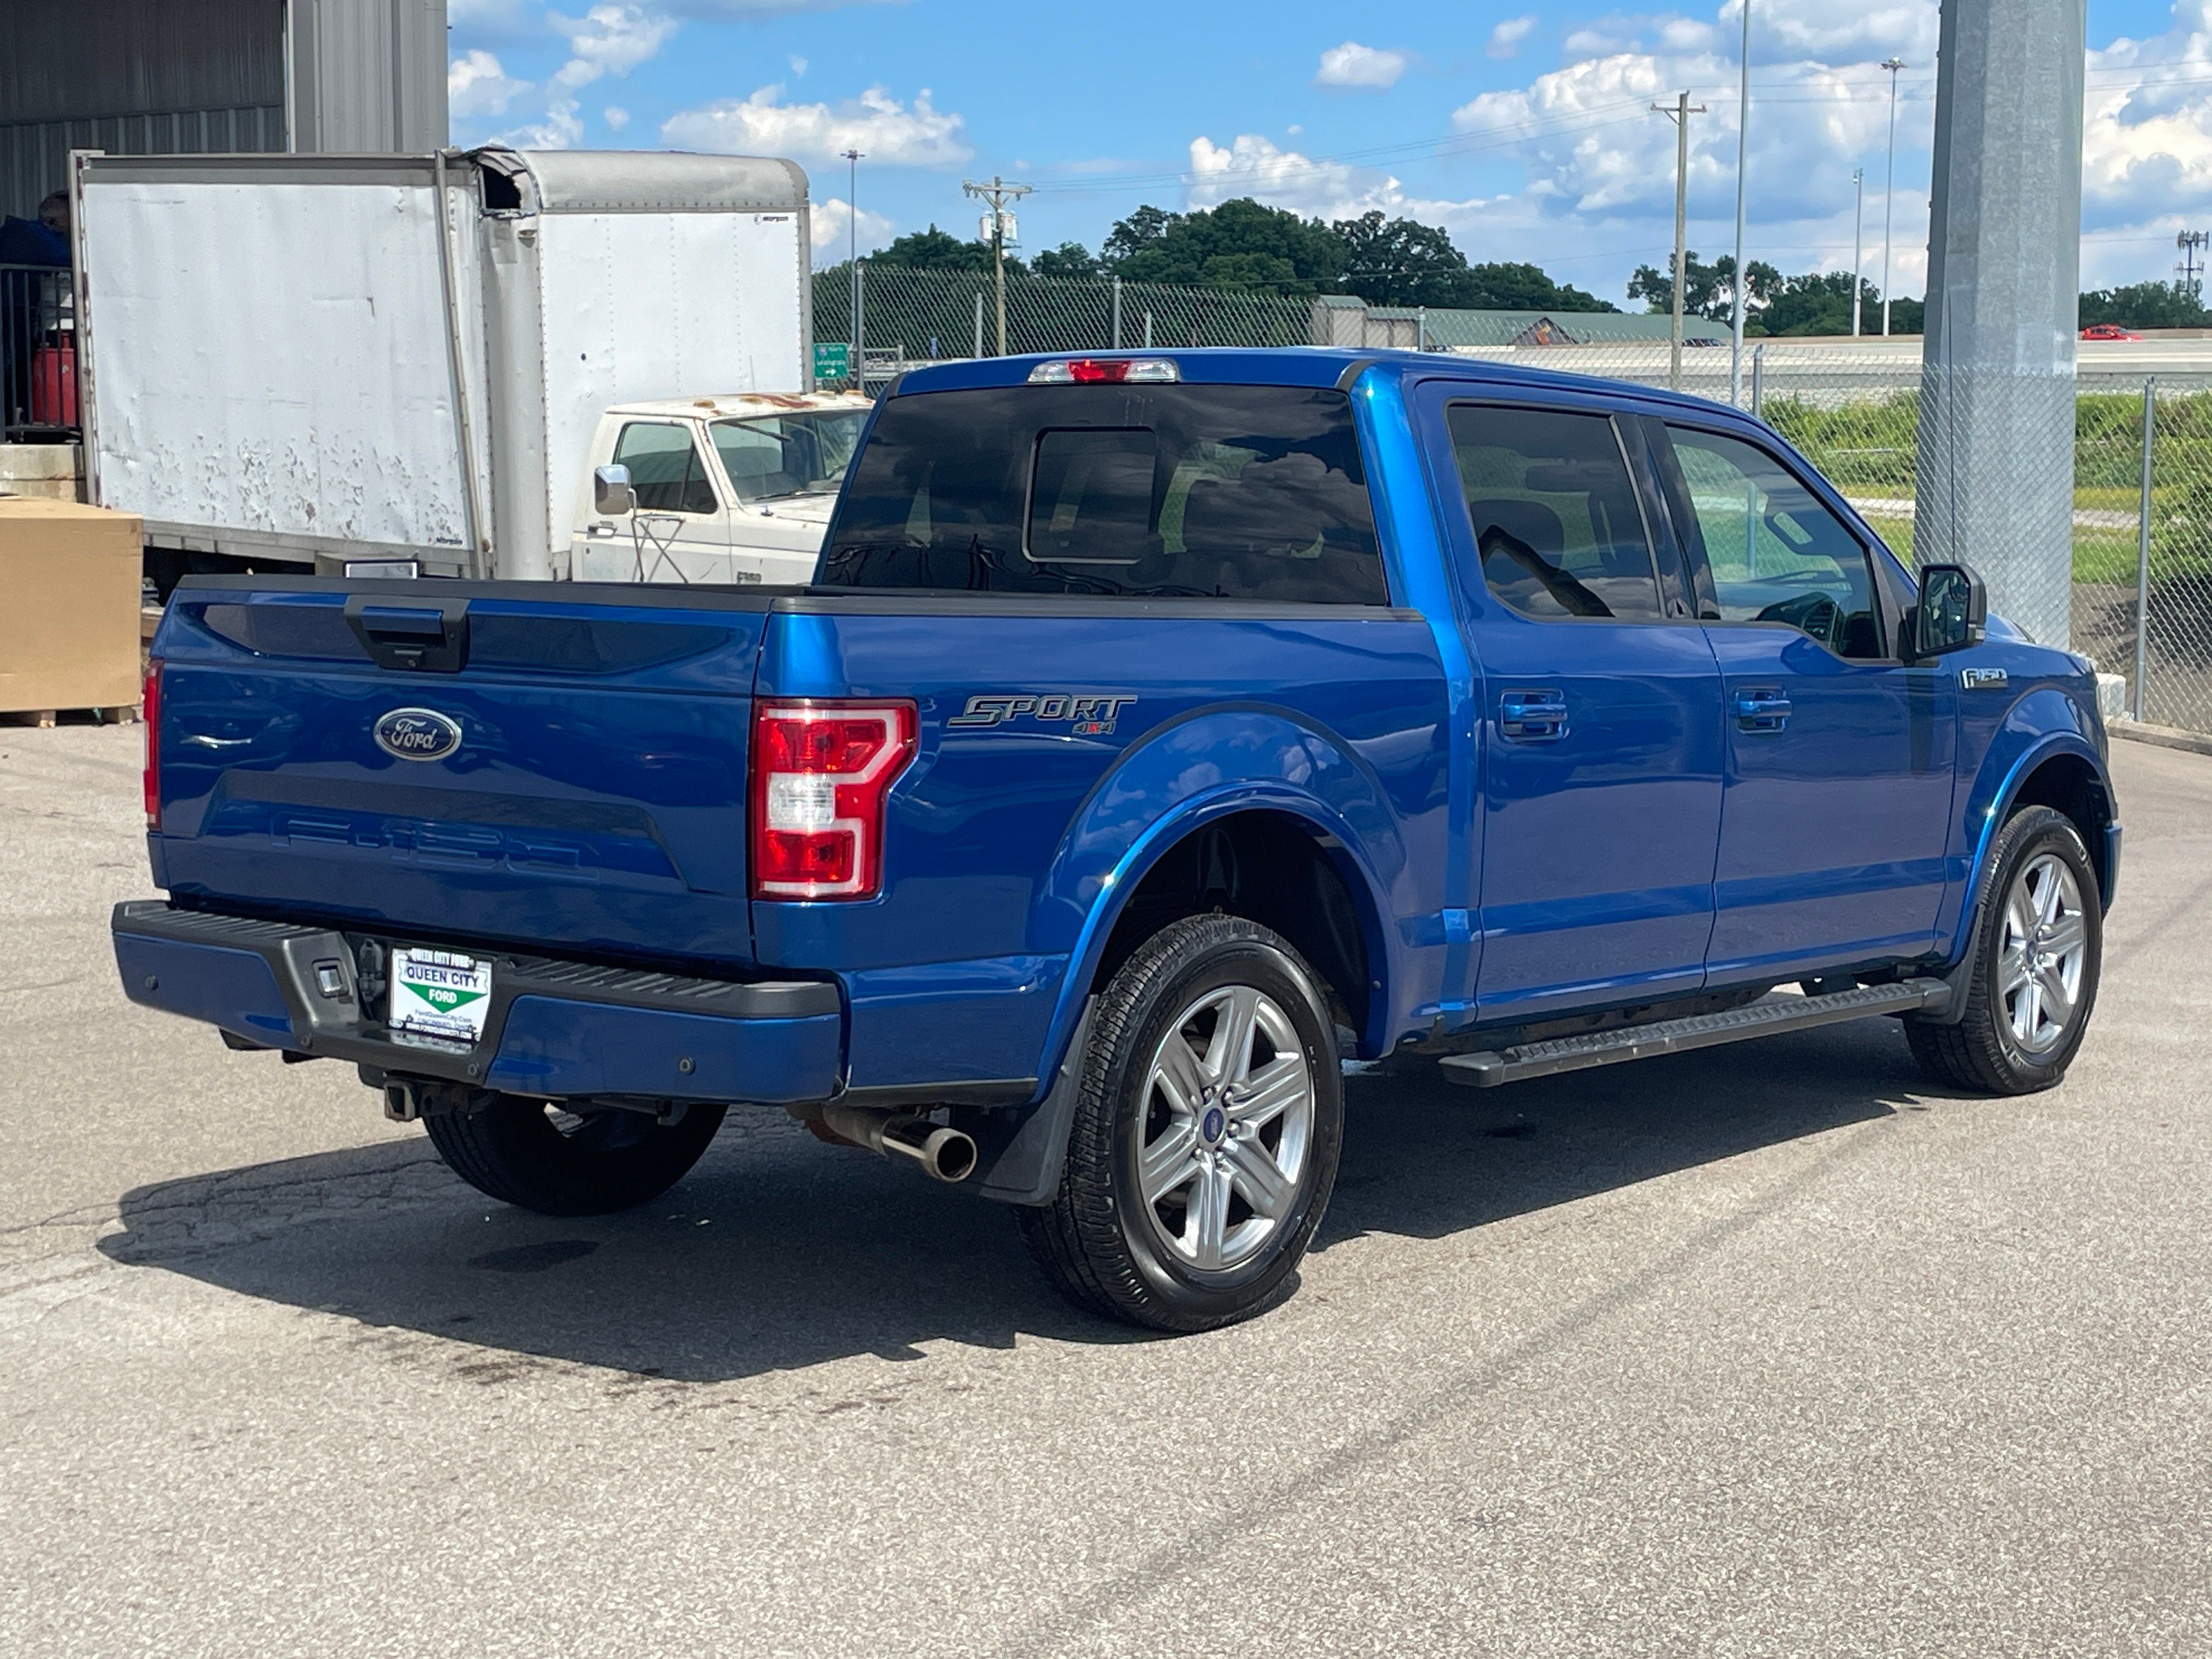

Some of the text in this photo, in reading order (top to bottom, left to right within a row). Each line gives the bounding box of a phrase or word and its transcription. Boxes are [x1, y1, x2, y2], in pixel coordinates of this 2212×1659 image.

[946, 695, 1138, 728] SPORT
[391, 718, 437, 749] Ford
[407, 966, 479, 988] QUEEN CITY
[428, 988, 457, 1004] FORD
